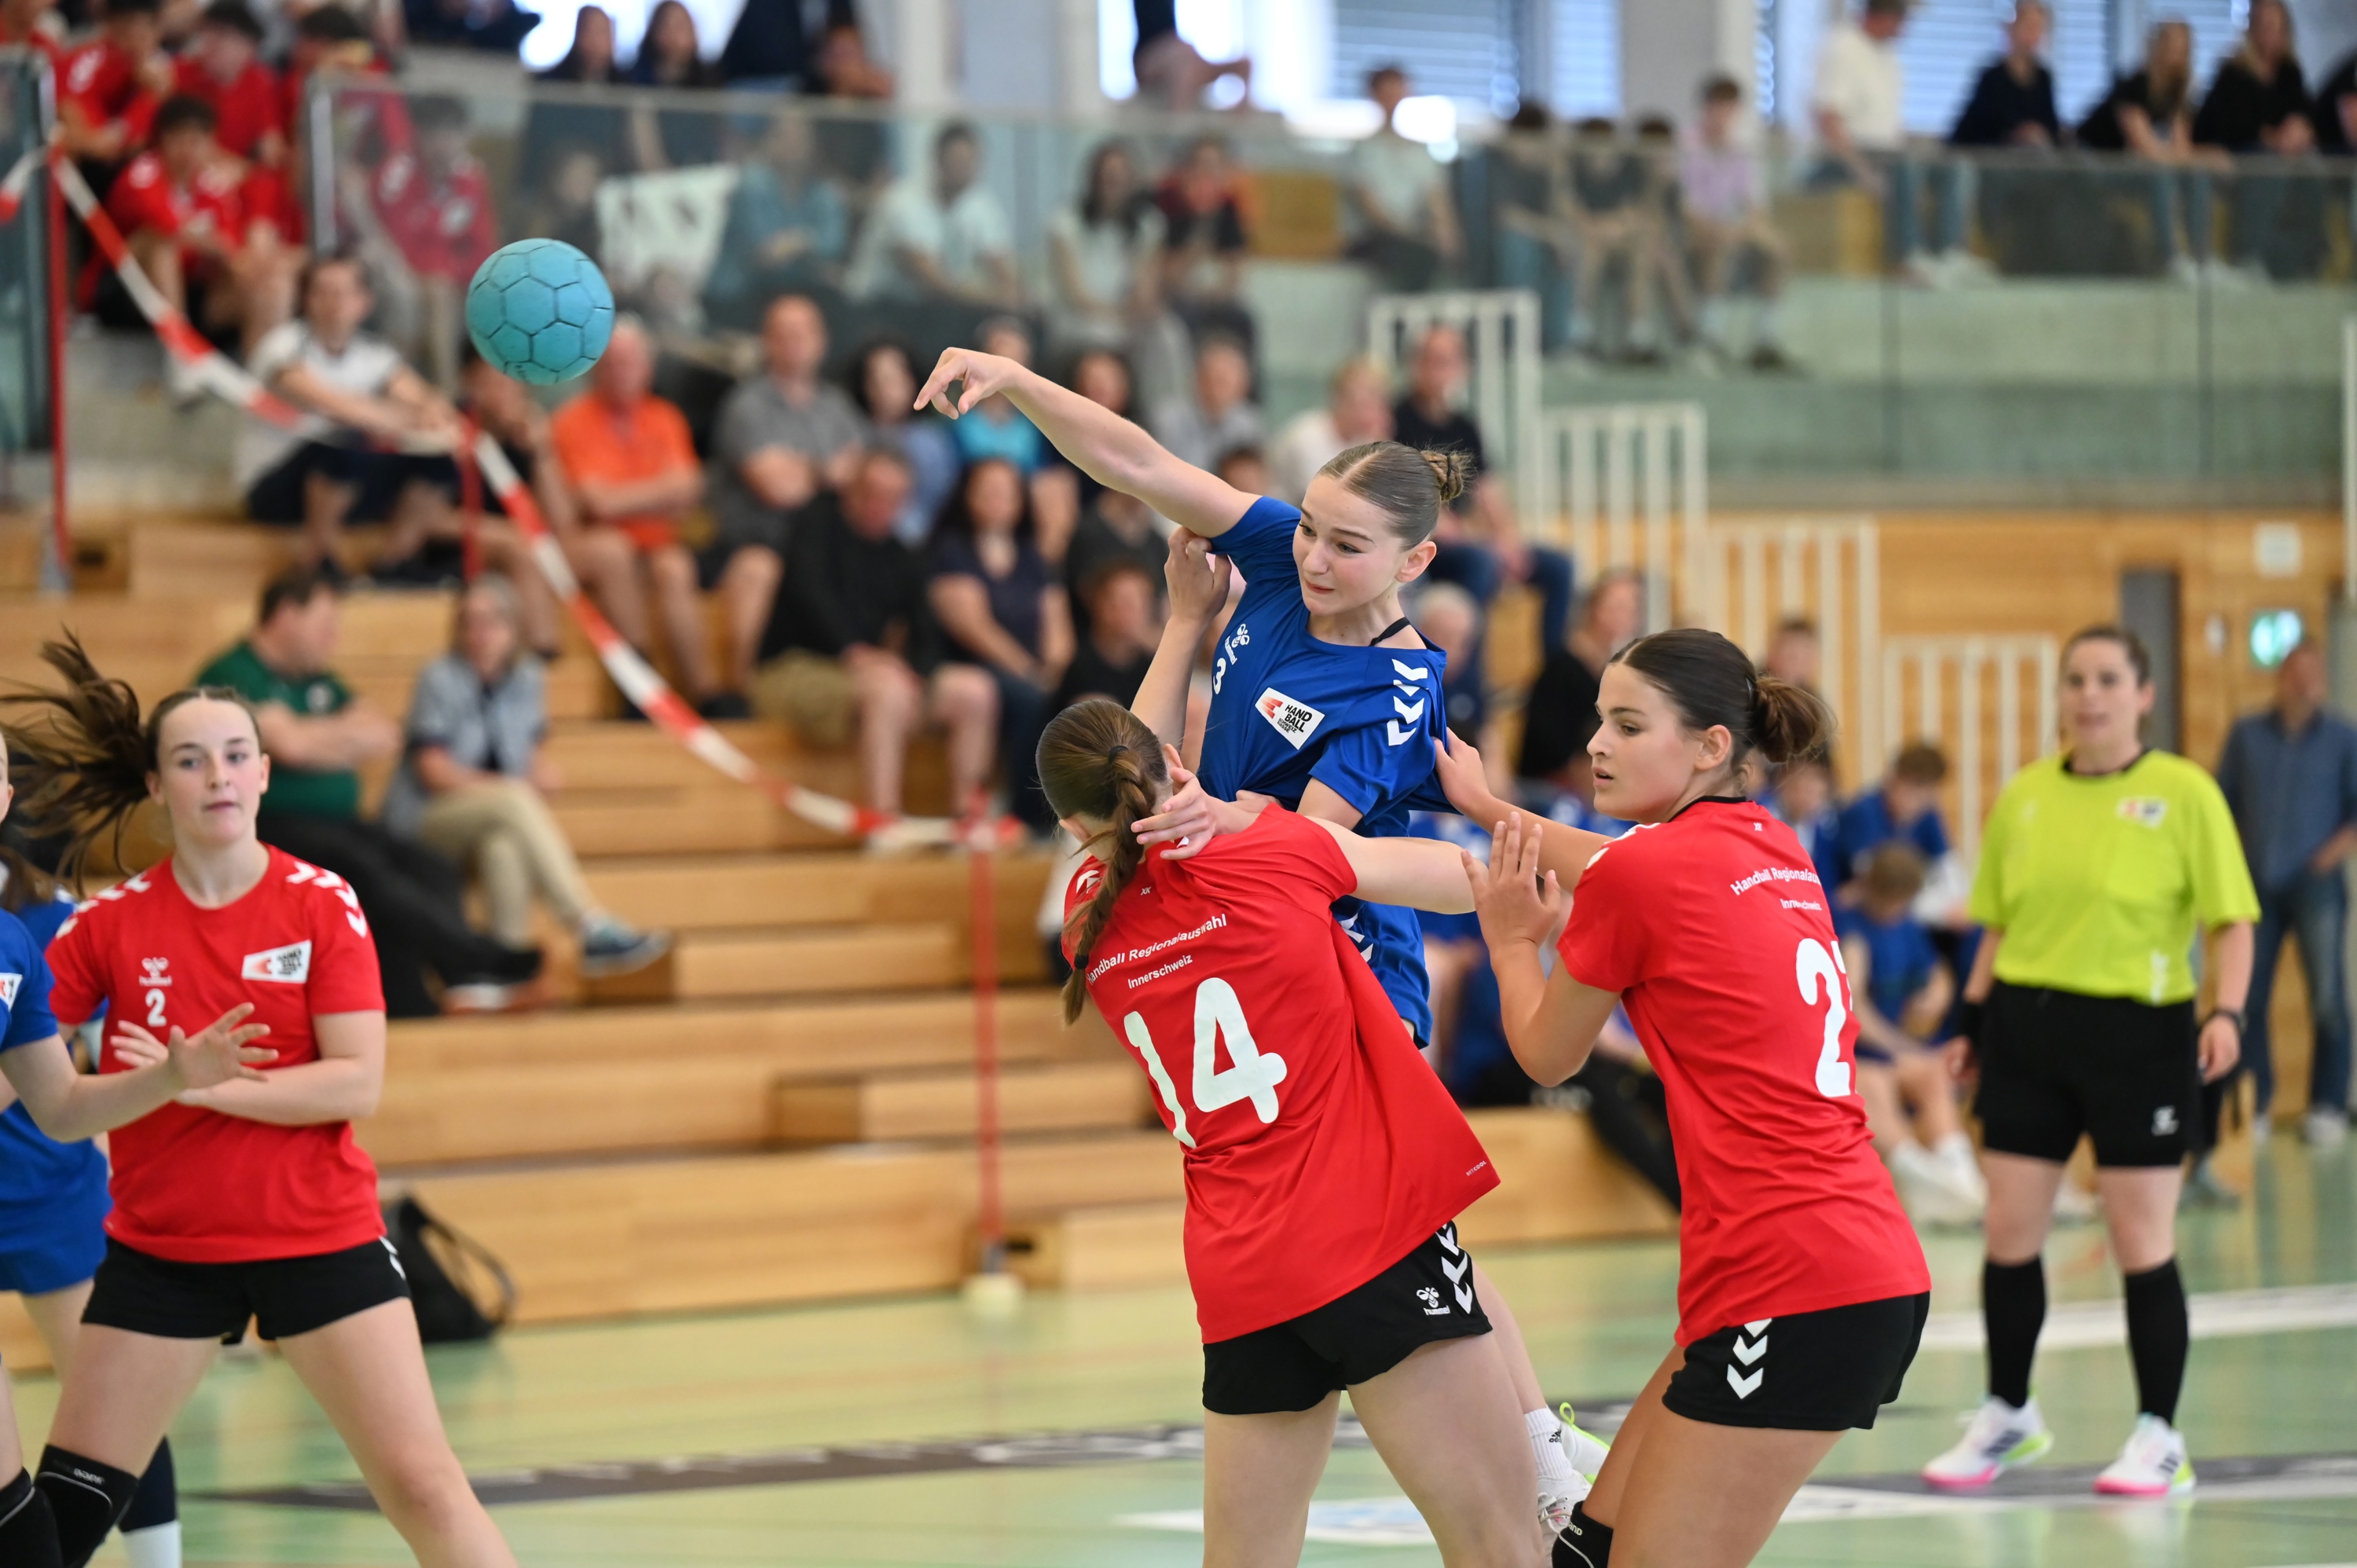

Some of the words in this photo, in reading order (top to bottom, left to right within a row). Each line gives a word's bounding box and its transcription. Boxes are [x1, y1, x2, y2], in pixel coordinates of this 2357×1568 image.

[1285, 704, 1313, 722] HAND
[1285, 713, 1306, 733] BALL
[1087, 953, 1125, 986] Handball
[1129, 914, 1227, 962] Regionalauswahl
[1127, 954, 1193, 989] Innerschweiz
[145, 988, 167, 1028] 2
[1796, 938, 1853, 1097] 2
[1124, 977, 1287, 1149] 14
[1423, 1305, 1450, 1316] hummel
